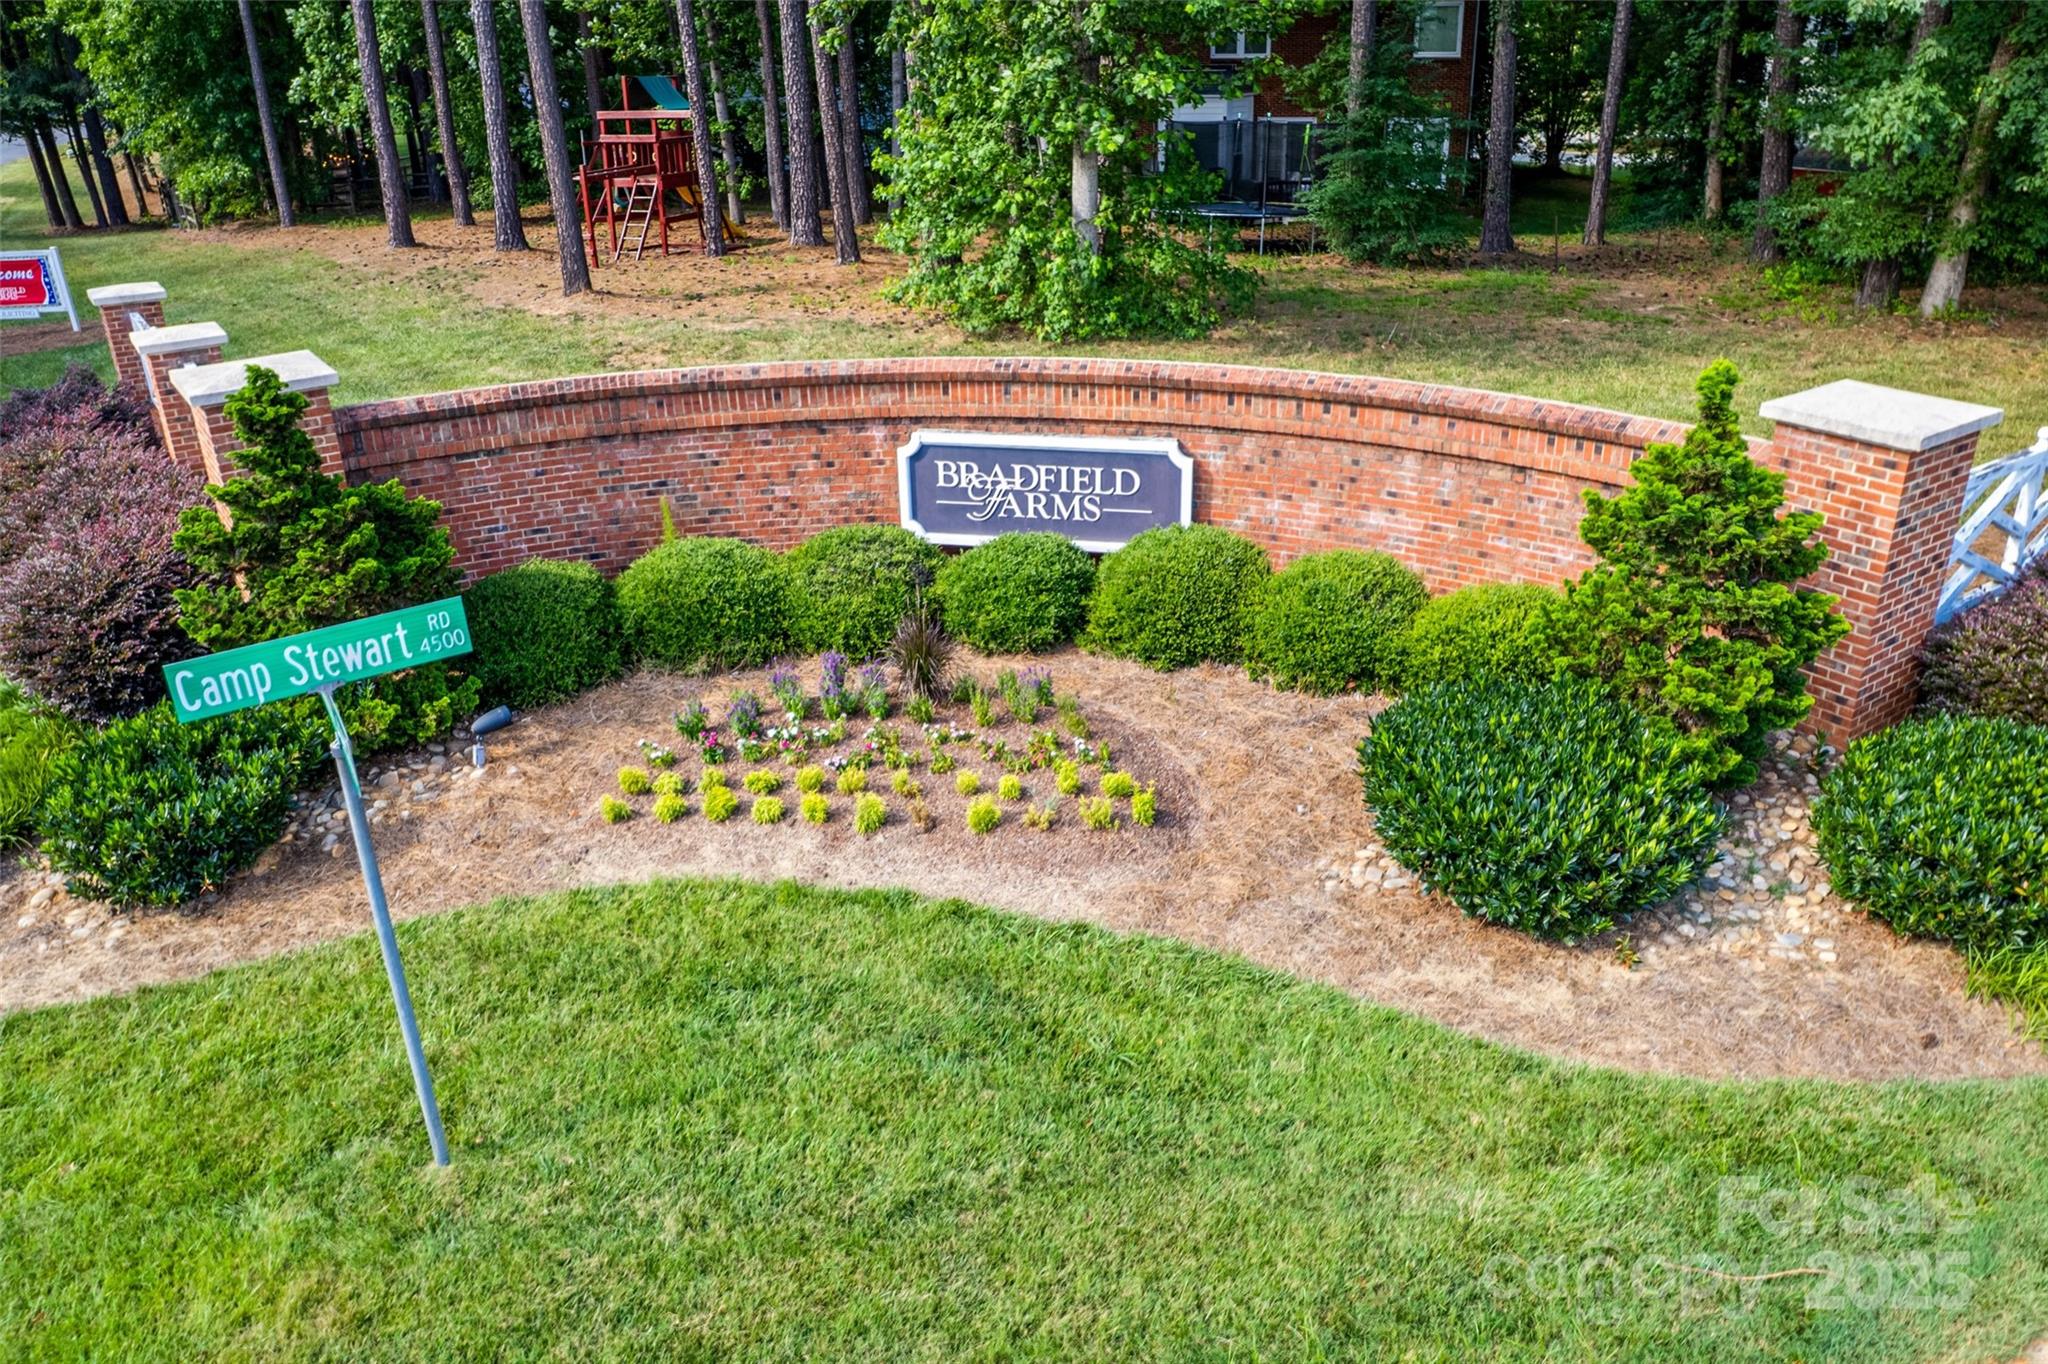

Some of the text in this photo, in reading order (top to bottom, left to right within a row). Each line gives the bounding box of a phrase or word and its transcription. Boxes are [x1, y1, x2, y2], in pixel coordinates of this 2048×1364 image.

[934, 460, 1141, 496] BRADFIELD
[966, 474, 1101, 521] FARMS
[175, 611, 451, 711] Camp Stewart RD
[419, 629, 466, 654] 4500
